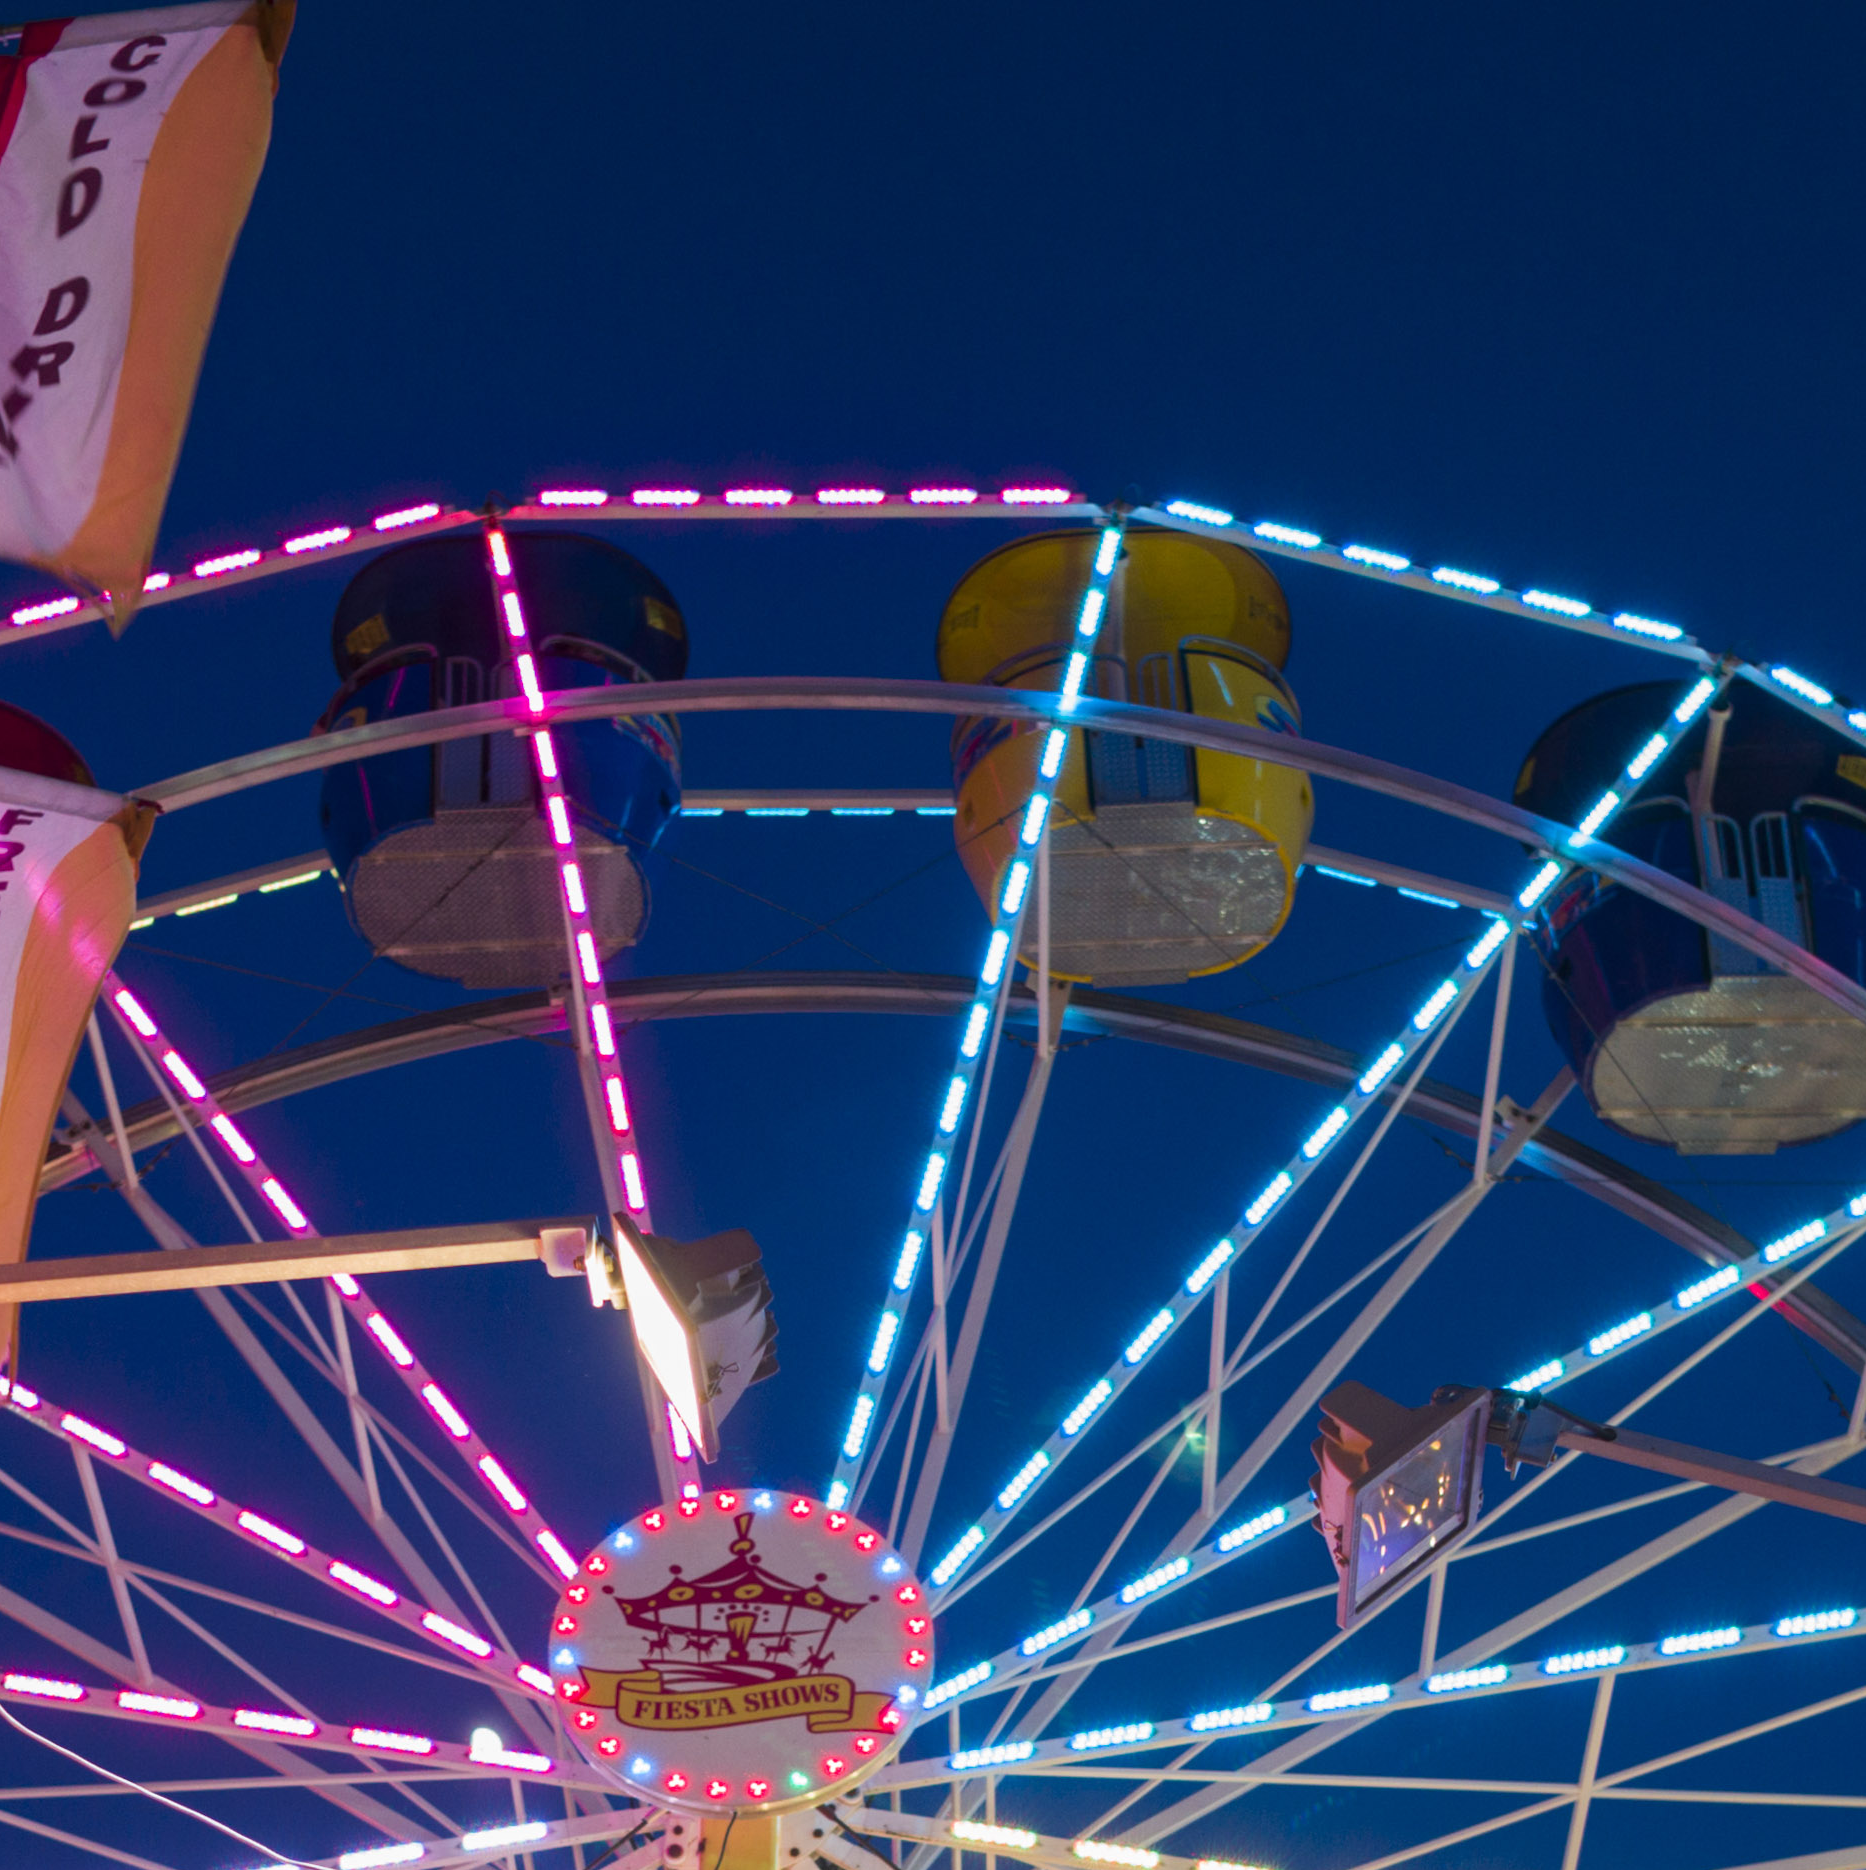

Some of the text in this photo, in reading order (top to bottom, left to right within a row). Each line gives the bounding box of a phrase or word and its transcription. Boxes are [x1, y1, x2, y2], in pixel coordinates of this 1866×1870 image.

[56, 34, 167, 239] COLD
[634, 1683, 841, 1721] FIESTA SHOWS
